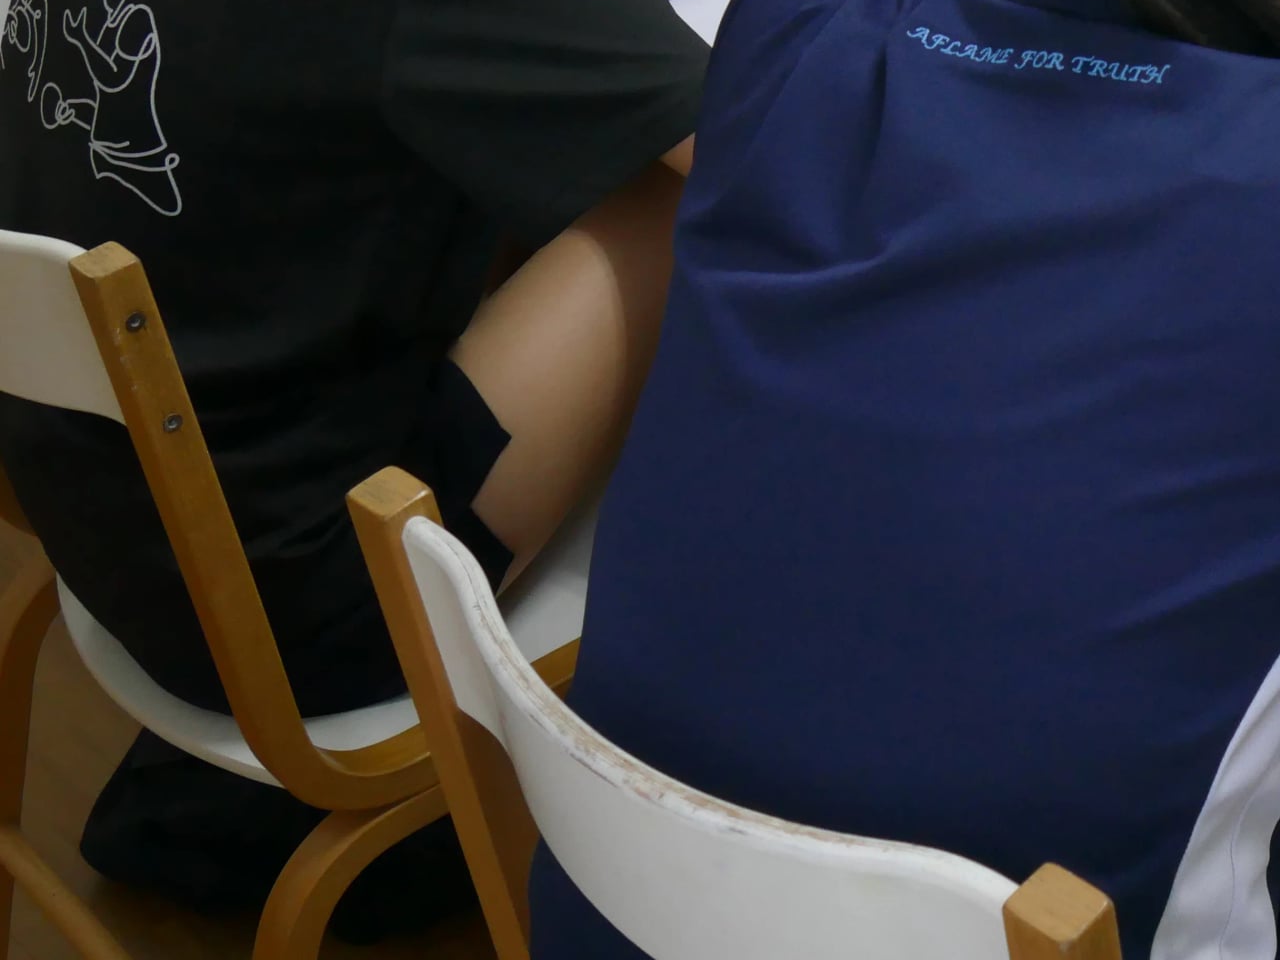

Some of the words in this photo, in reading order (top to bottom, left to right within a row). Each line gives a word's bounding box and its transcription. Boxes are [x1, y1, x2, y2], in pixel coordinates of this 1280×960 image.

[906, 26, 1013, 64] AFLAME
[1014, 49, 1065, 70] FOR
[1071, 55, 1171, 84] TRUTH
